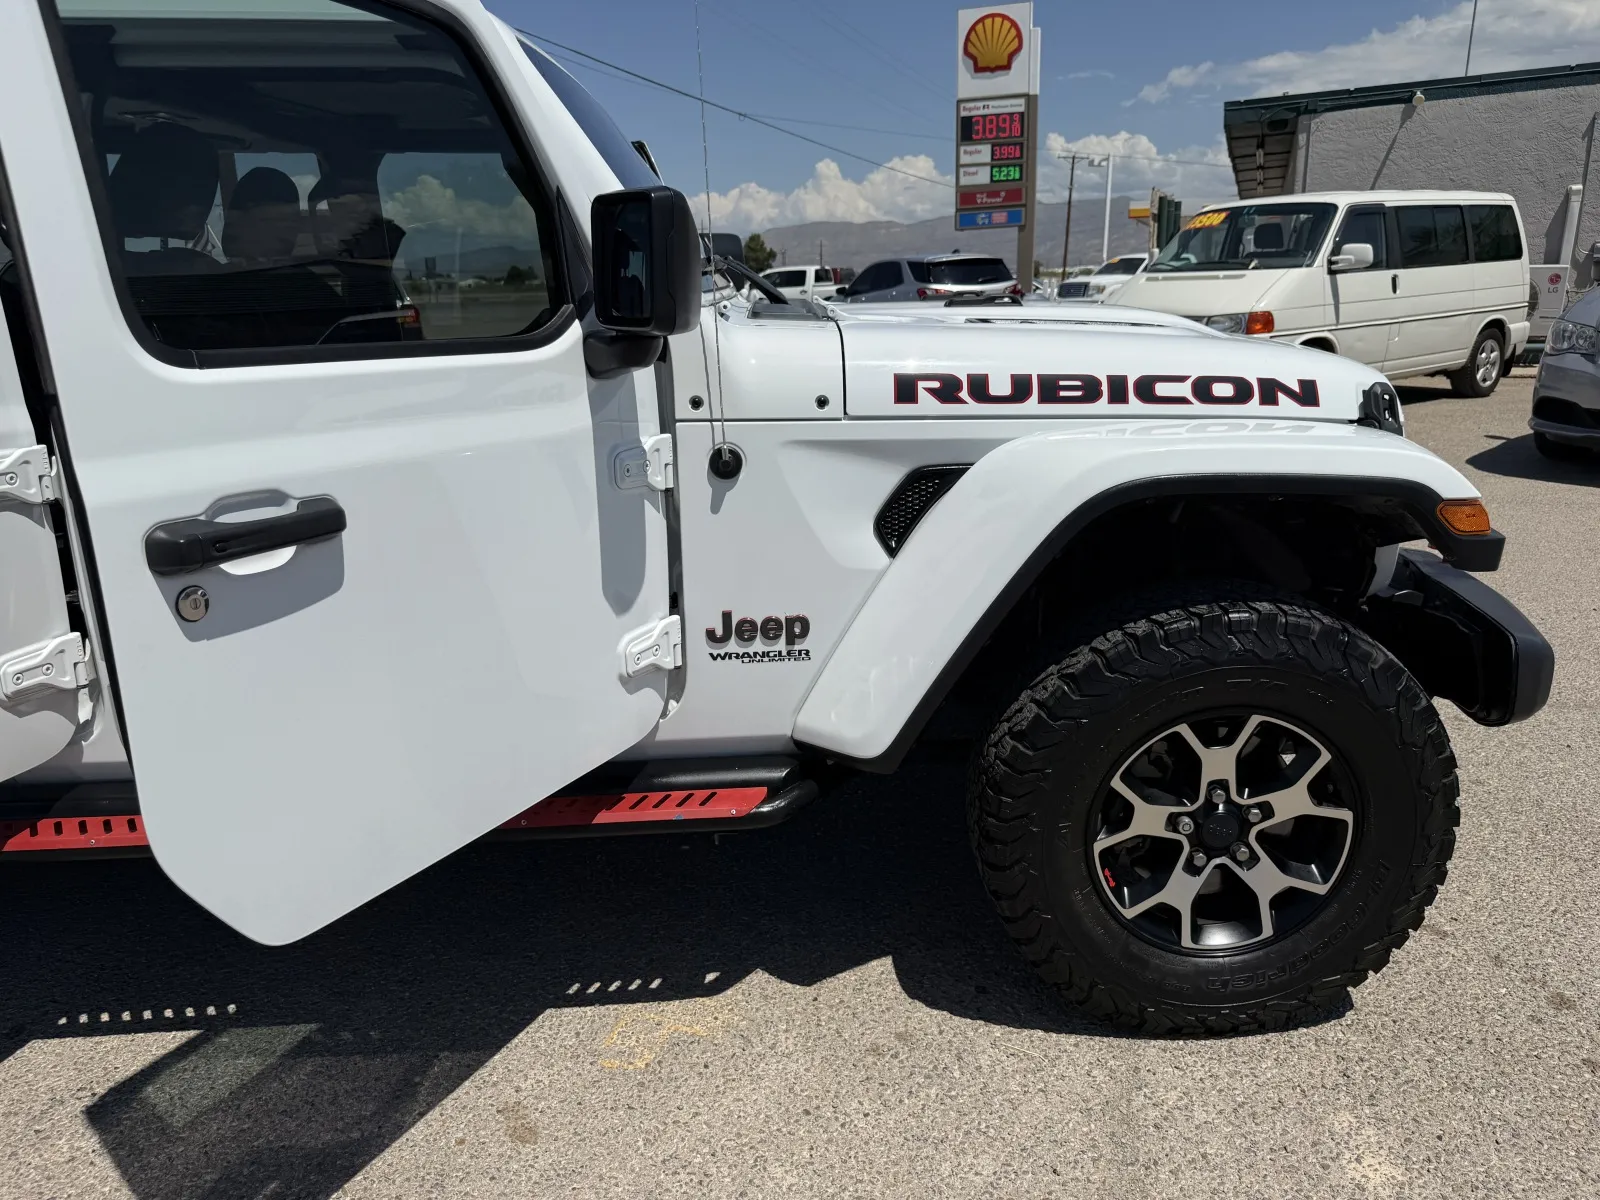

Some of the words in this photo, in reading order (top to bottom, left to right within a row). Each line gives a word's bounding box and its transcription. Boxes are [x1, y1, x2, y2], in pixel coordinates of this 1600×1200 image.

[962, 104, 981, 113] Regular
[1547, 286, 1559, 294] LG
[893, 373, 1320, 407] RUBICON
[705, 610, 811, 646] Jeep
[708, 649, 811, 661] WRANGLER
[741, 656, 812, 664] UNLIMITED
